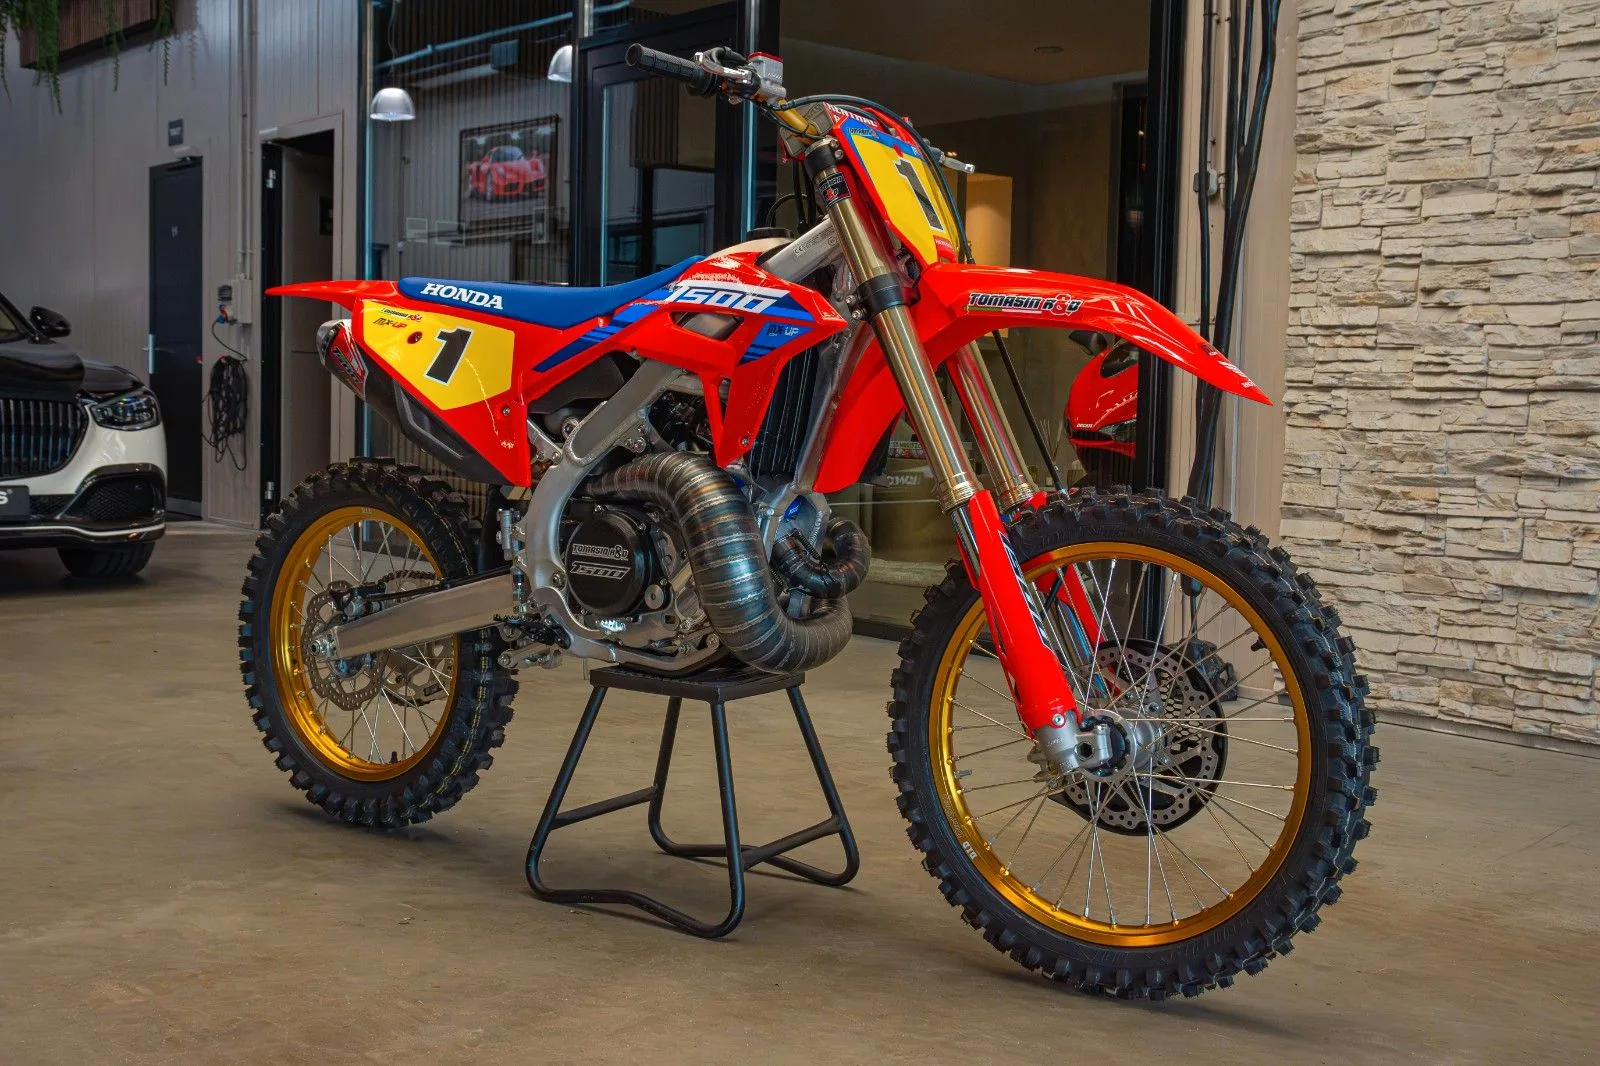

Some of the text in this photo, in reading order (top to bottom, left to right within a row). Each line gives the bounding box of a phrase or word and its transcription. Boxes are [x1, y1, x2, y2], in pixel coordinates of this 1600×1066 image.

[893, 157, 946, 234] 1
[420, 283, 504, 310] HONDA
[967, 292, 1084, 316] TOMASIN R&D
[373, 317, 408, 329] MX-UP
[423, 326, 475, 386] 1
[572, 543, 609, 558] TOMASIN
